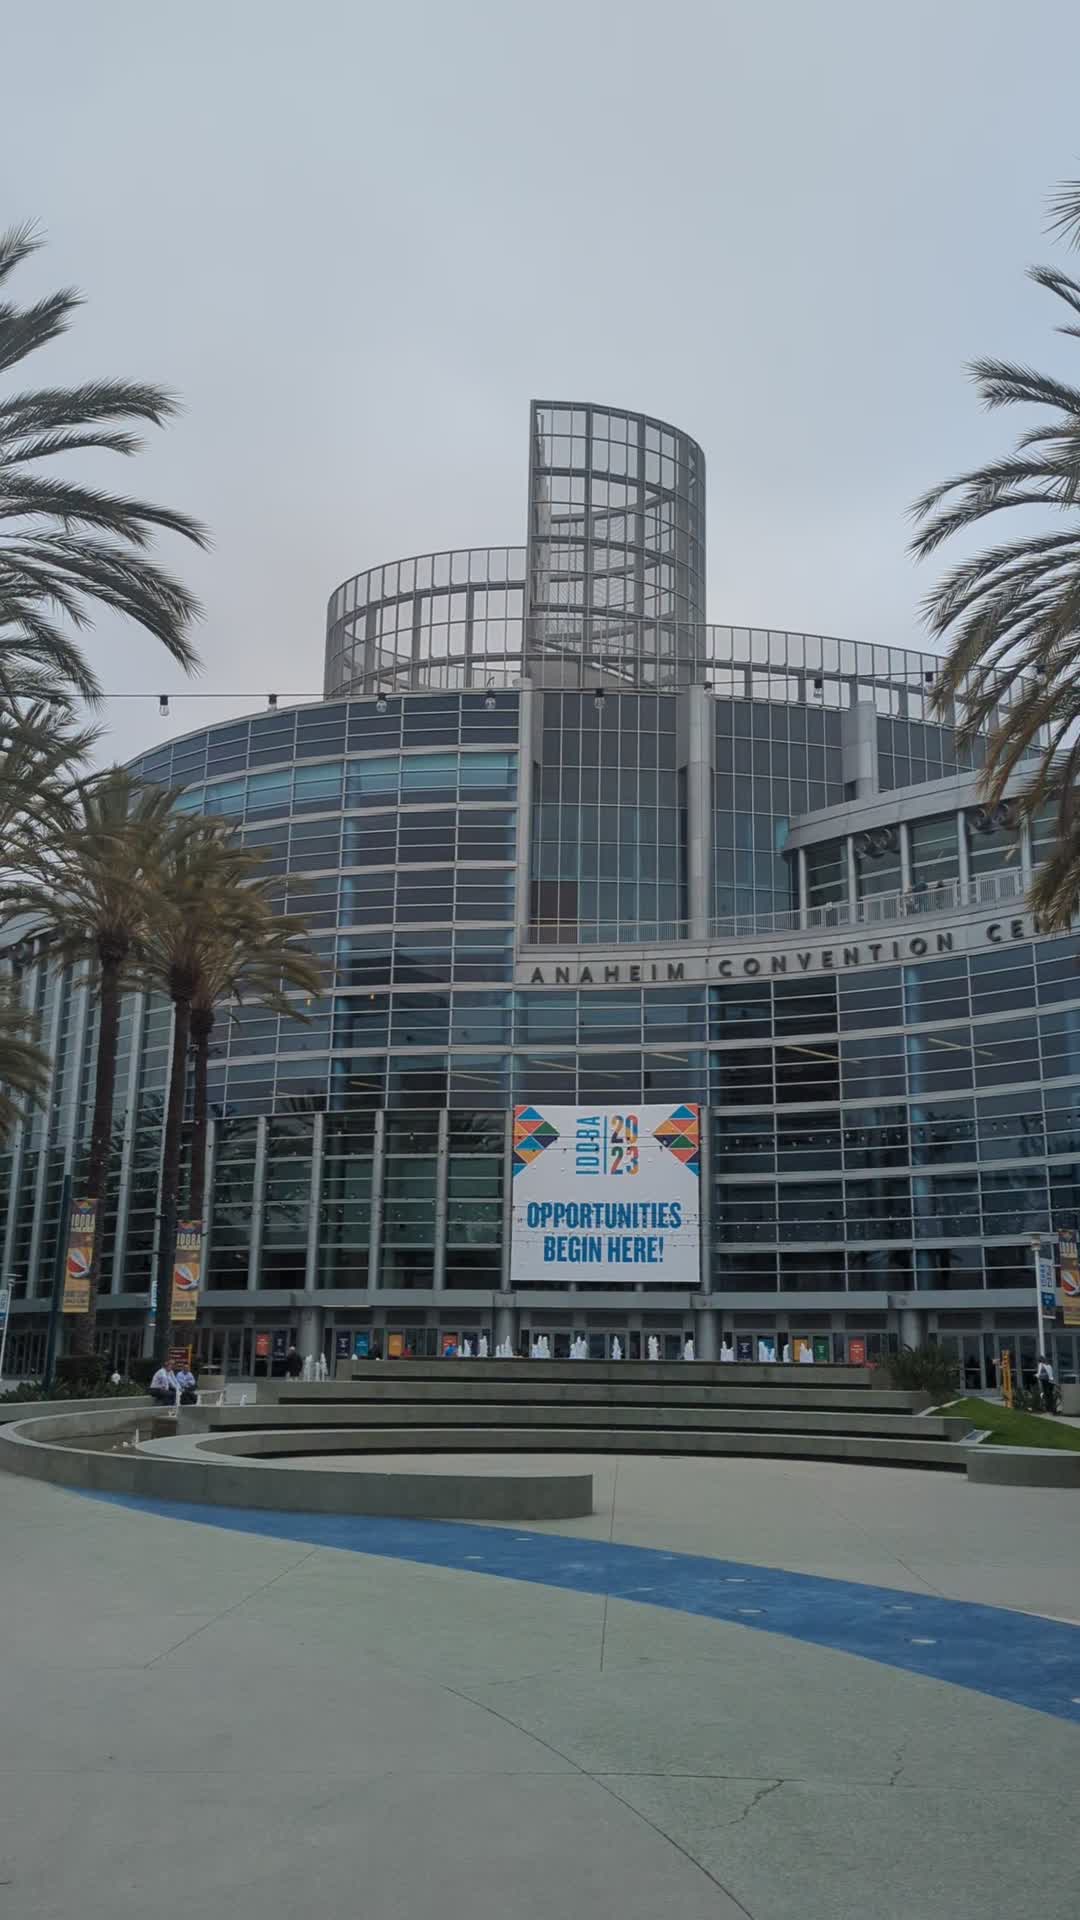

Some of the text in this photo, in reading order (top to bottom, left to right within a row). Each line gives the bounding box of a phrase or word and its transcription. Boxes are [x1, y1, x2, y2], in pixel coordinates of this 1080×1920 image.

[531, 961, 687, 984] ANAHEIM
[718, 931, 955, 977] CONVENTION
[611, 1114, 639, 1144] 20
[576, 1116, 601, 1175] IDDBA
[611, 1146, 640, 1175] 23
[527, 1201, 682, 1229] OPPORTUNITIES
[544, 1236, 664, 1263] BEGIN HERE!
